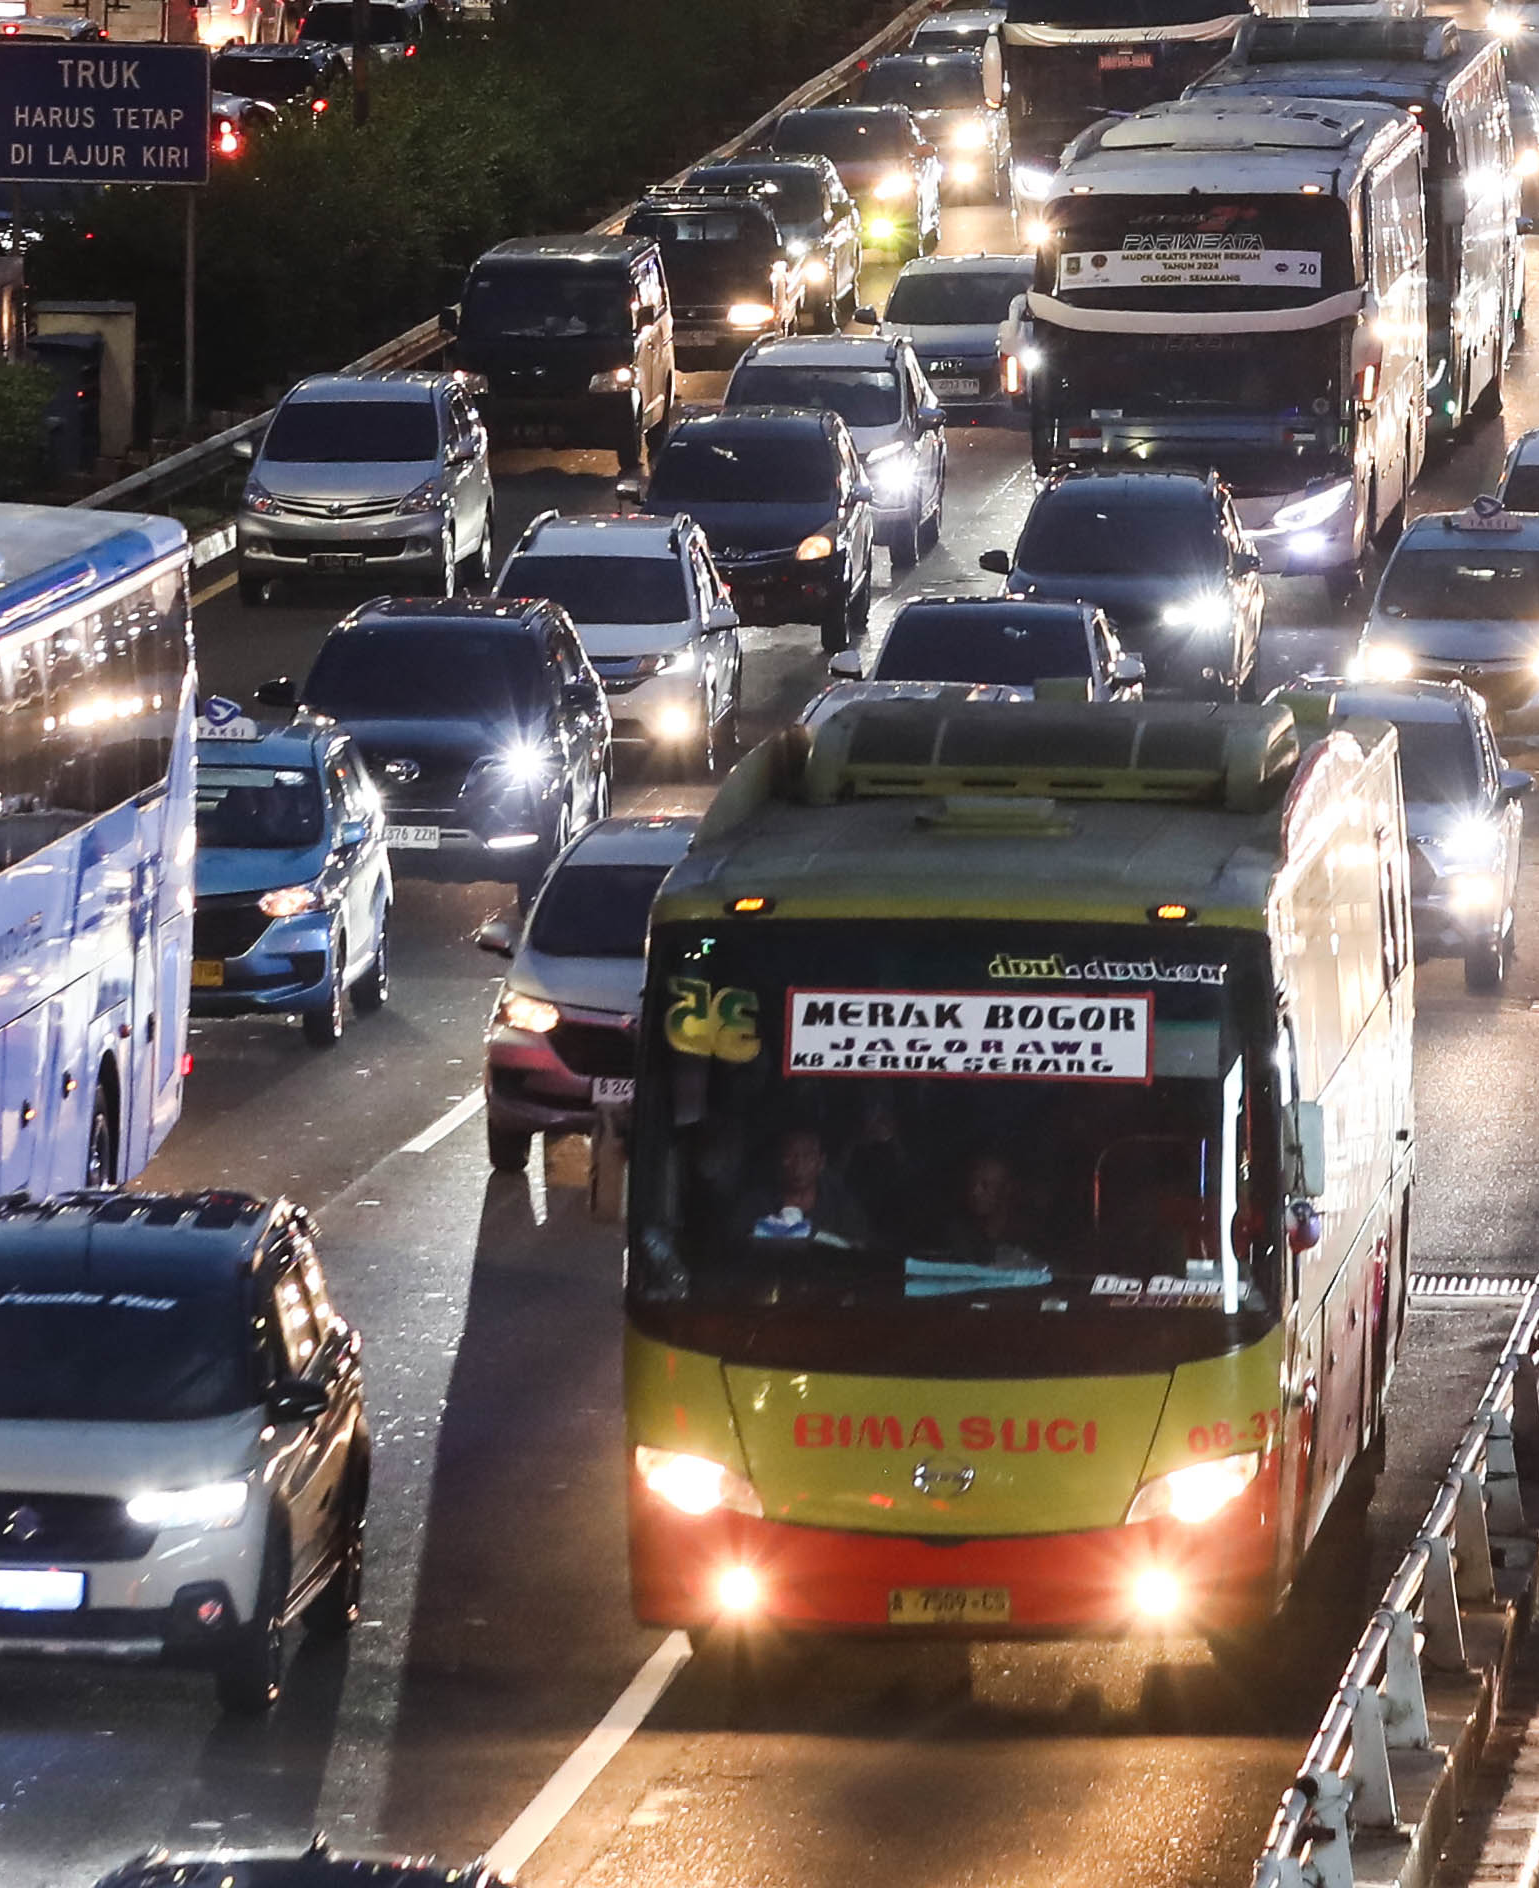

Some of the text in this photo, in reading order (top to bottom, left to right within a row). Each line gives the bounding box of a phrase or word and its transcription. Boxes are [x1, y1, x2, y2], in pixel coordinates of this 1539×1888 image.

[58, 60, 141, 89] TRUK
[14, 106, 184, 129] HARUS TETAP
[11, 143, 189, 168] DI LAJUR KIRI
[1122, 234, 1265, 250] PARIWISATA
[1122, 253, 1260, 261] MUDIK GRATIS PENUH BERKAH
[1162, 263, 1195, 271] TAHUN
[1299, 263, 1317, 276] 20
[1141, 274, 1181, 283] CILEGON
[1189, 274, 1240, 283] SEMARANG
[802, 1000, 1136, 1032] MERAK BOGOR
[829, 1037, 1103, 1056] JAGORAWI
[792, 1052, 824, 1068] KB
[833, 1053, 948, 1071] JERUK
[793, 1414, 1098, 1454] BIMA SUCI
